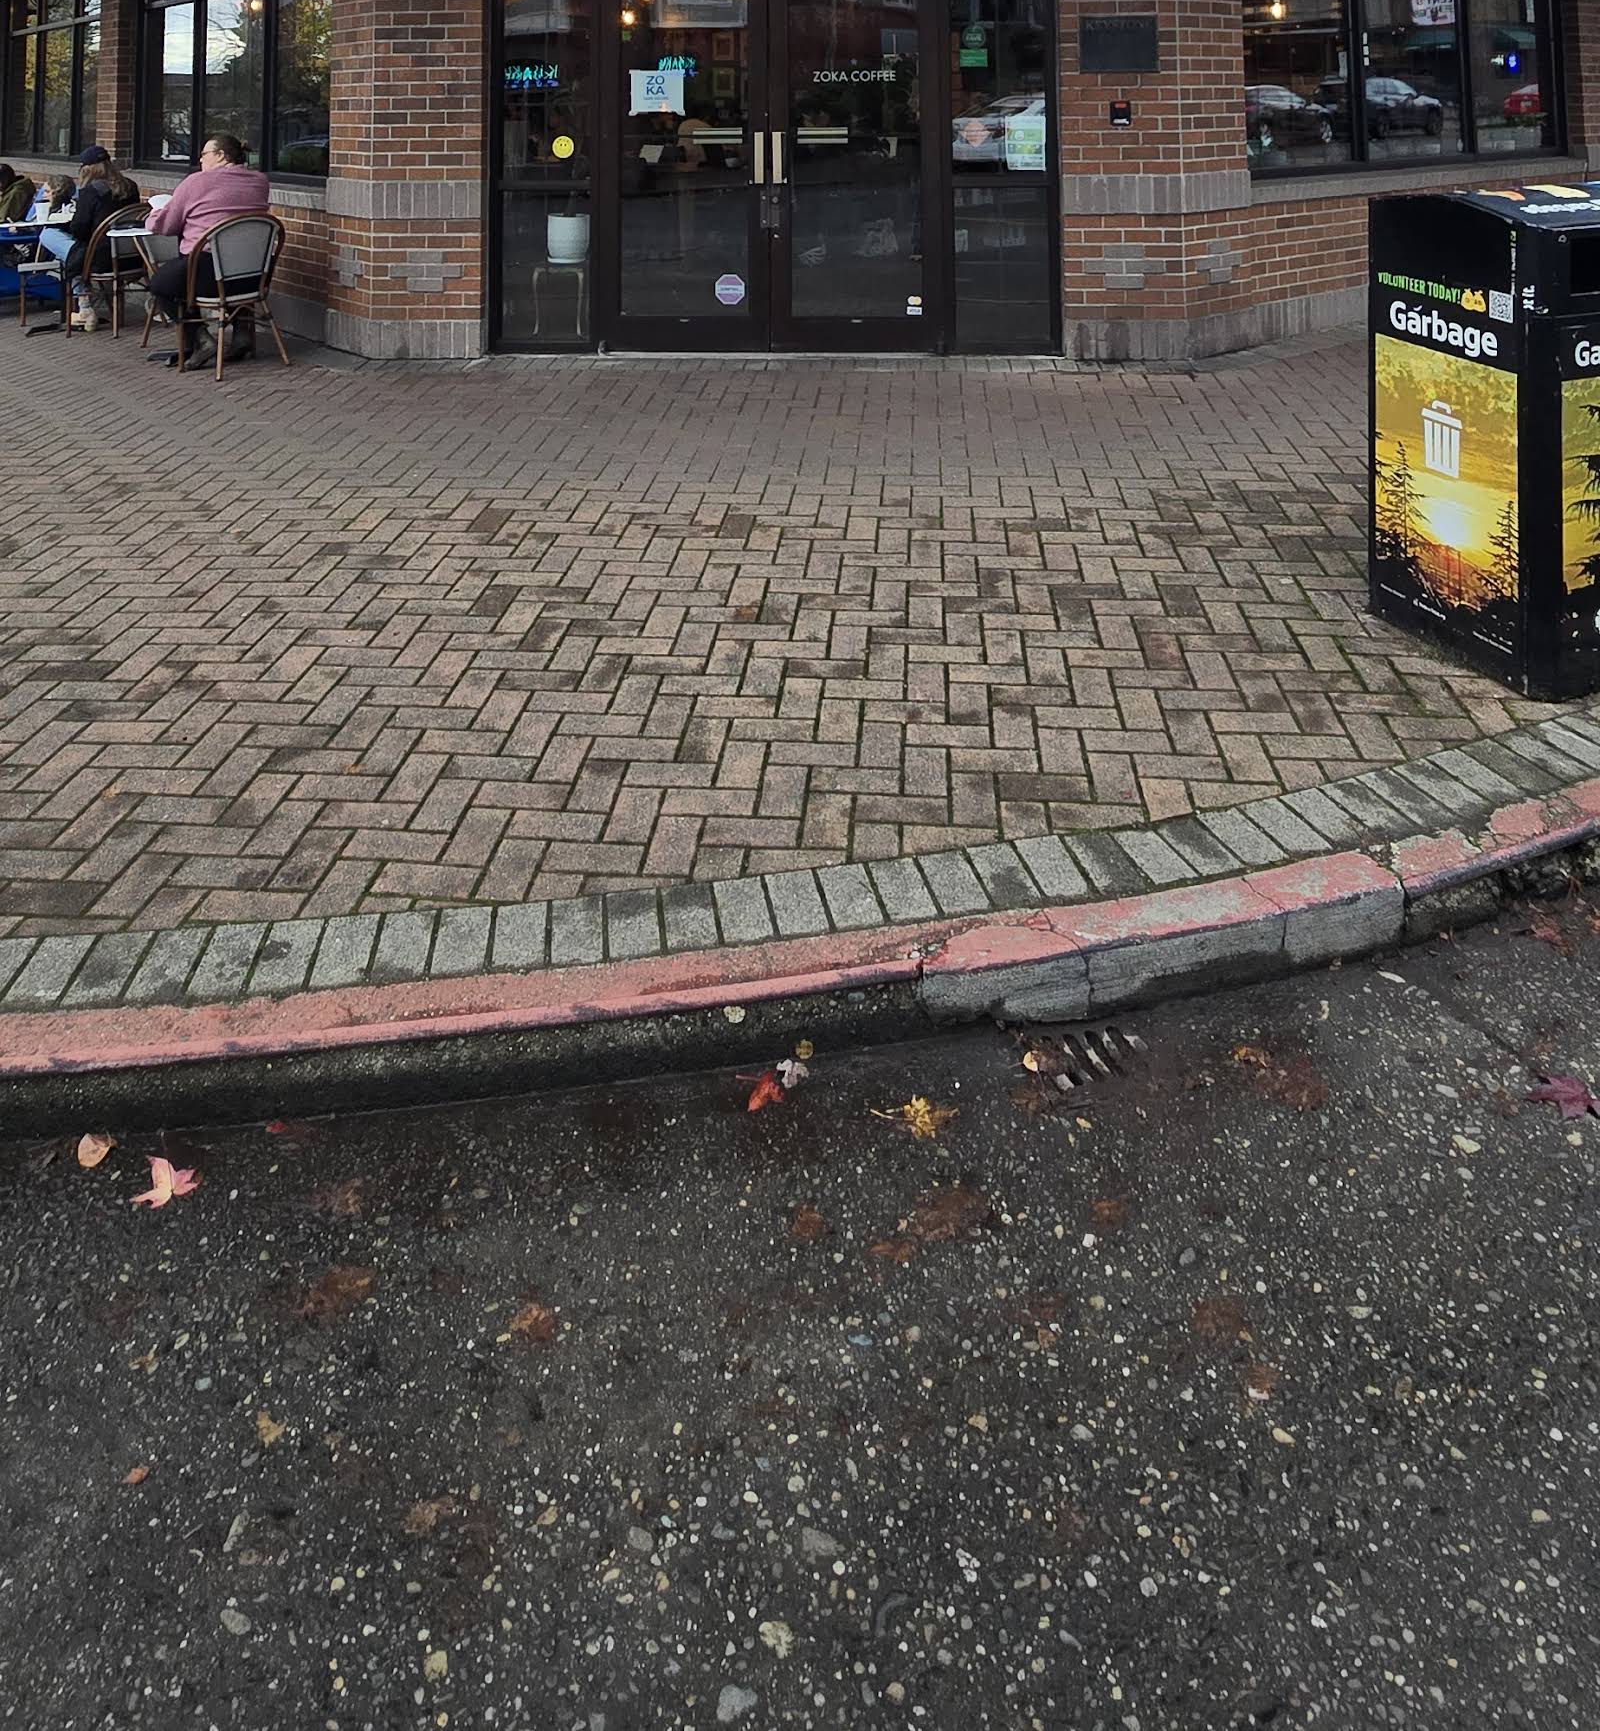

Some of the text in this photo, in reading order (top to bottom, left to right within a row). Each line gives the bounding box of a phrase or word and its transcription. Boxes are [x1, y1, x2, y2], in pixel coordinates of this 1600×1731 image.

[646, 75, 665, 85] ZO
[813, 70, 897, 82] ZOKA COFFEE
[646, 86, 665, 95] KA
[1377, 272, 1461, 304] VOLUNTEER TODAY!
[1389, 300, 1498, 358] Garbage
